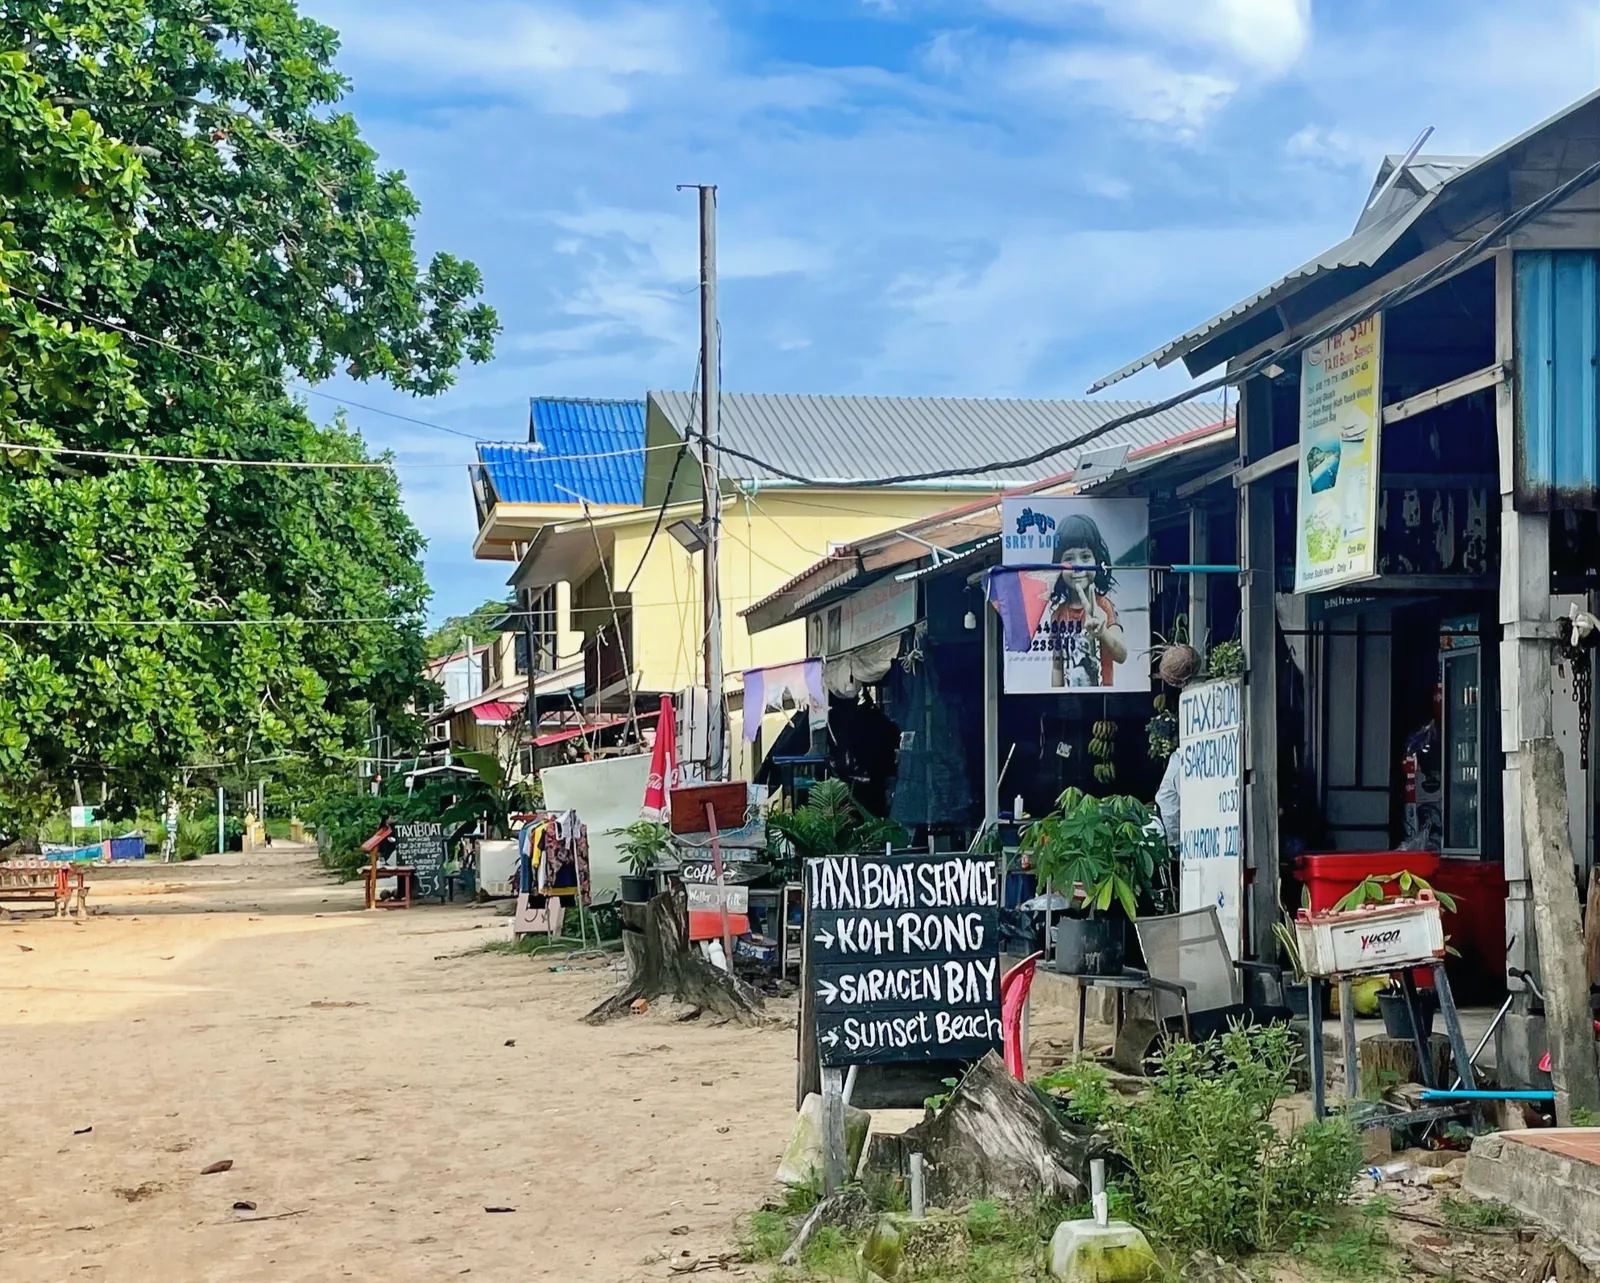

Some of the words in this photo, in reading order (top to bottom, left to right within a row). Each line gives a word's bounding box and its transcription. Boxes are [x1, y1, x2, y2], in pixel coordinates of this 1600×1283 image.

[1005, 534, 1034, 549] SREY
[1218, 788, 1239, 813] 10:30
[807, 857, 861, 909] TAXI
[862, 862, 915, 909] BOAT
[917, 858, 998, 908] SERVICE
[837, 917, 894, 955] KOH
[897, 912, 984, 954] RONG
[839, 963, 941, 1004] SARACEN
[943, 958, 996, 1005] BAY
[843, 1011, 933, 1050] Sunset
[935, 1009, 1004, 1044] Beach
